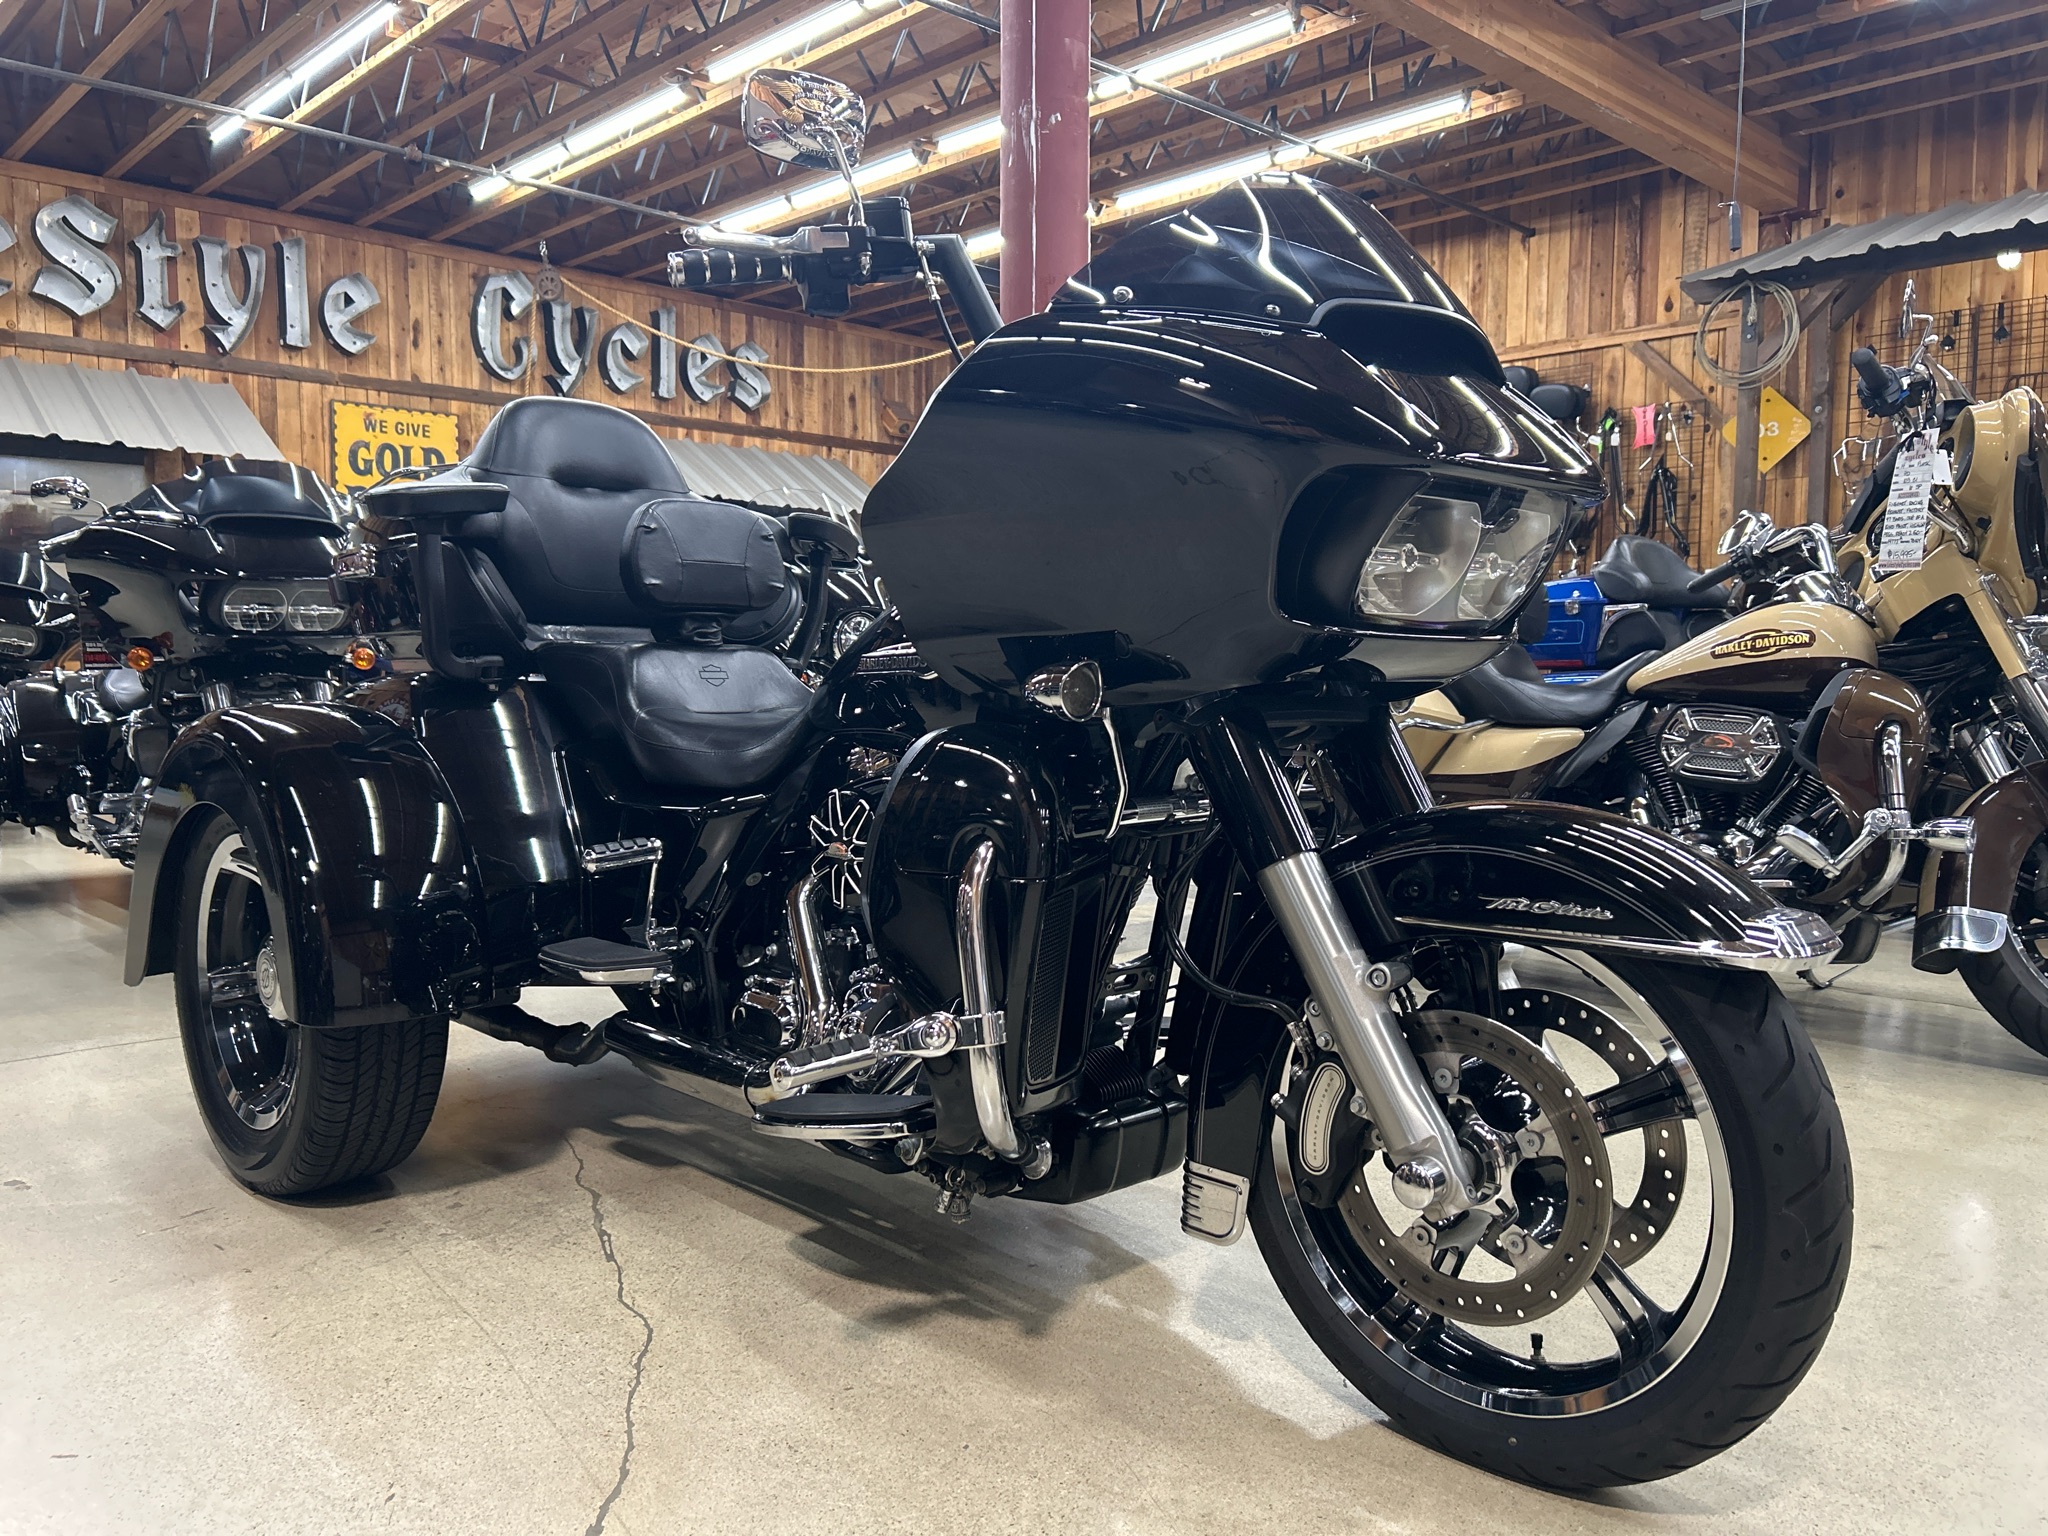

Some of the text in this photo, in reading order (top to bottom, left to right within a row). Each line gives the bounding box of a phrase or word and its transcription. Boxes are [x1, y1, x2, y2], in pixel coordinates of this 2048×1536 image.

[471, 269, 771, 412] Cycles
[363, 418, 431, 439] WE GIVE
[348, 440, 446, 479] GOLD
[1715, 634, 1810, 655] HARLEY-DAVIDSON
[858, 656, 927, 670] HARLEY-DAVIDS
